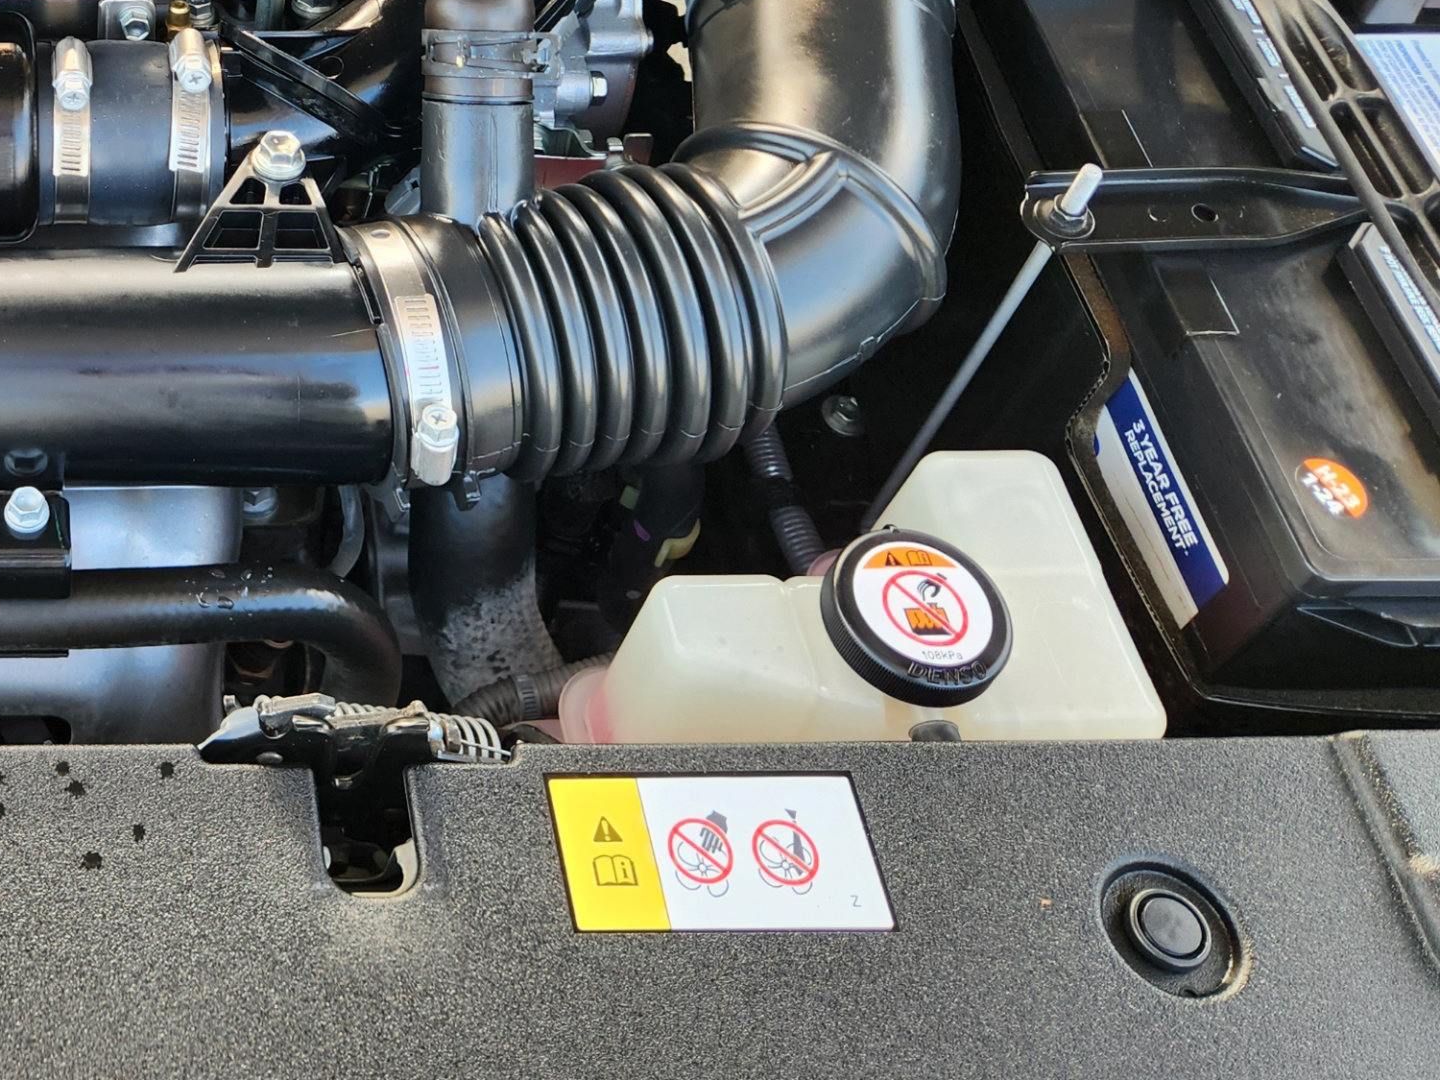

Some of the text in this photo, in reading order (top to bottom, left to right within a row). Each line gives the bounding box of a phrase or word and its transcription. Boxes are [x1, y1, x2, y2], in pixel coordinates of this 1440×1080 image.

[1133, 419, 1199, 548] 3 YEAR FREE
[1314, 465, 1361, 509] H-23
[921, 650, 964, 660] 108kPa
[907, 661, 987, 685] DENSO
[850, 895, 862, 907] Z
